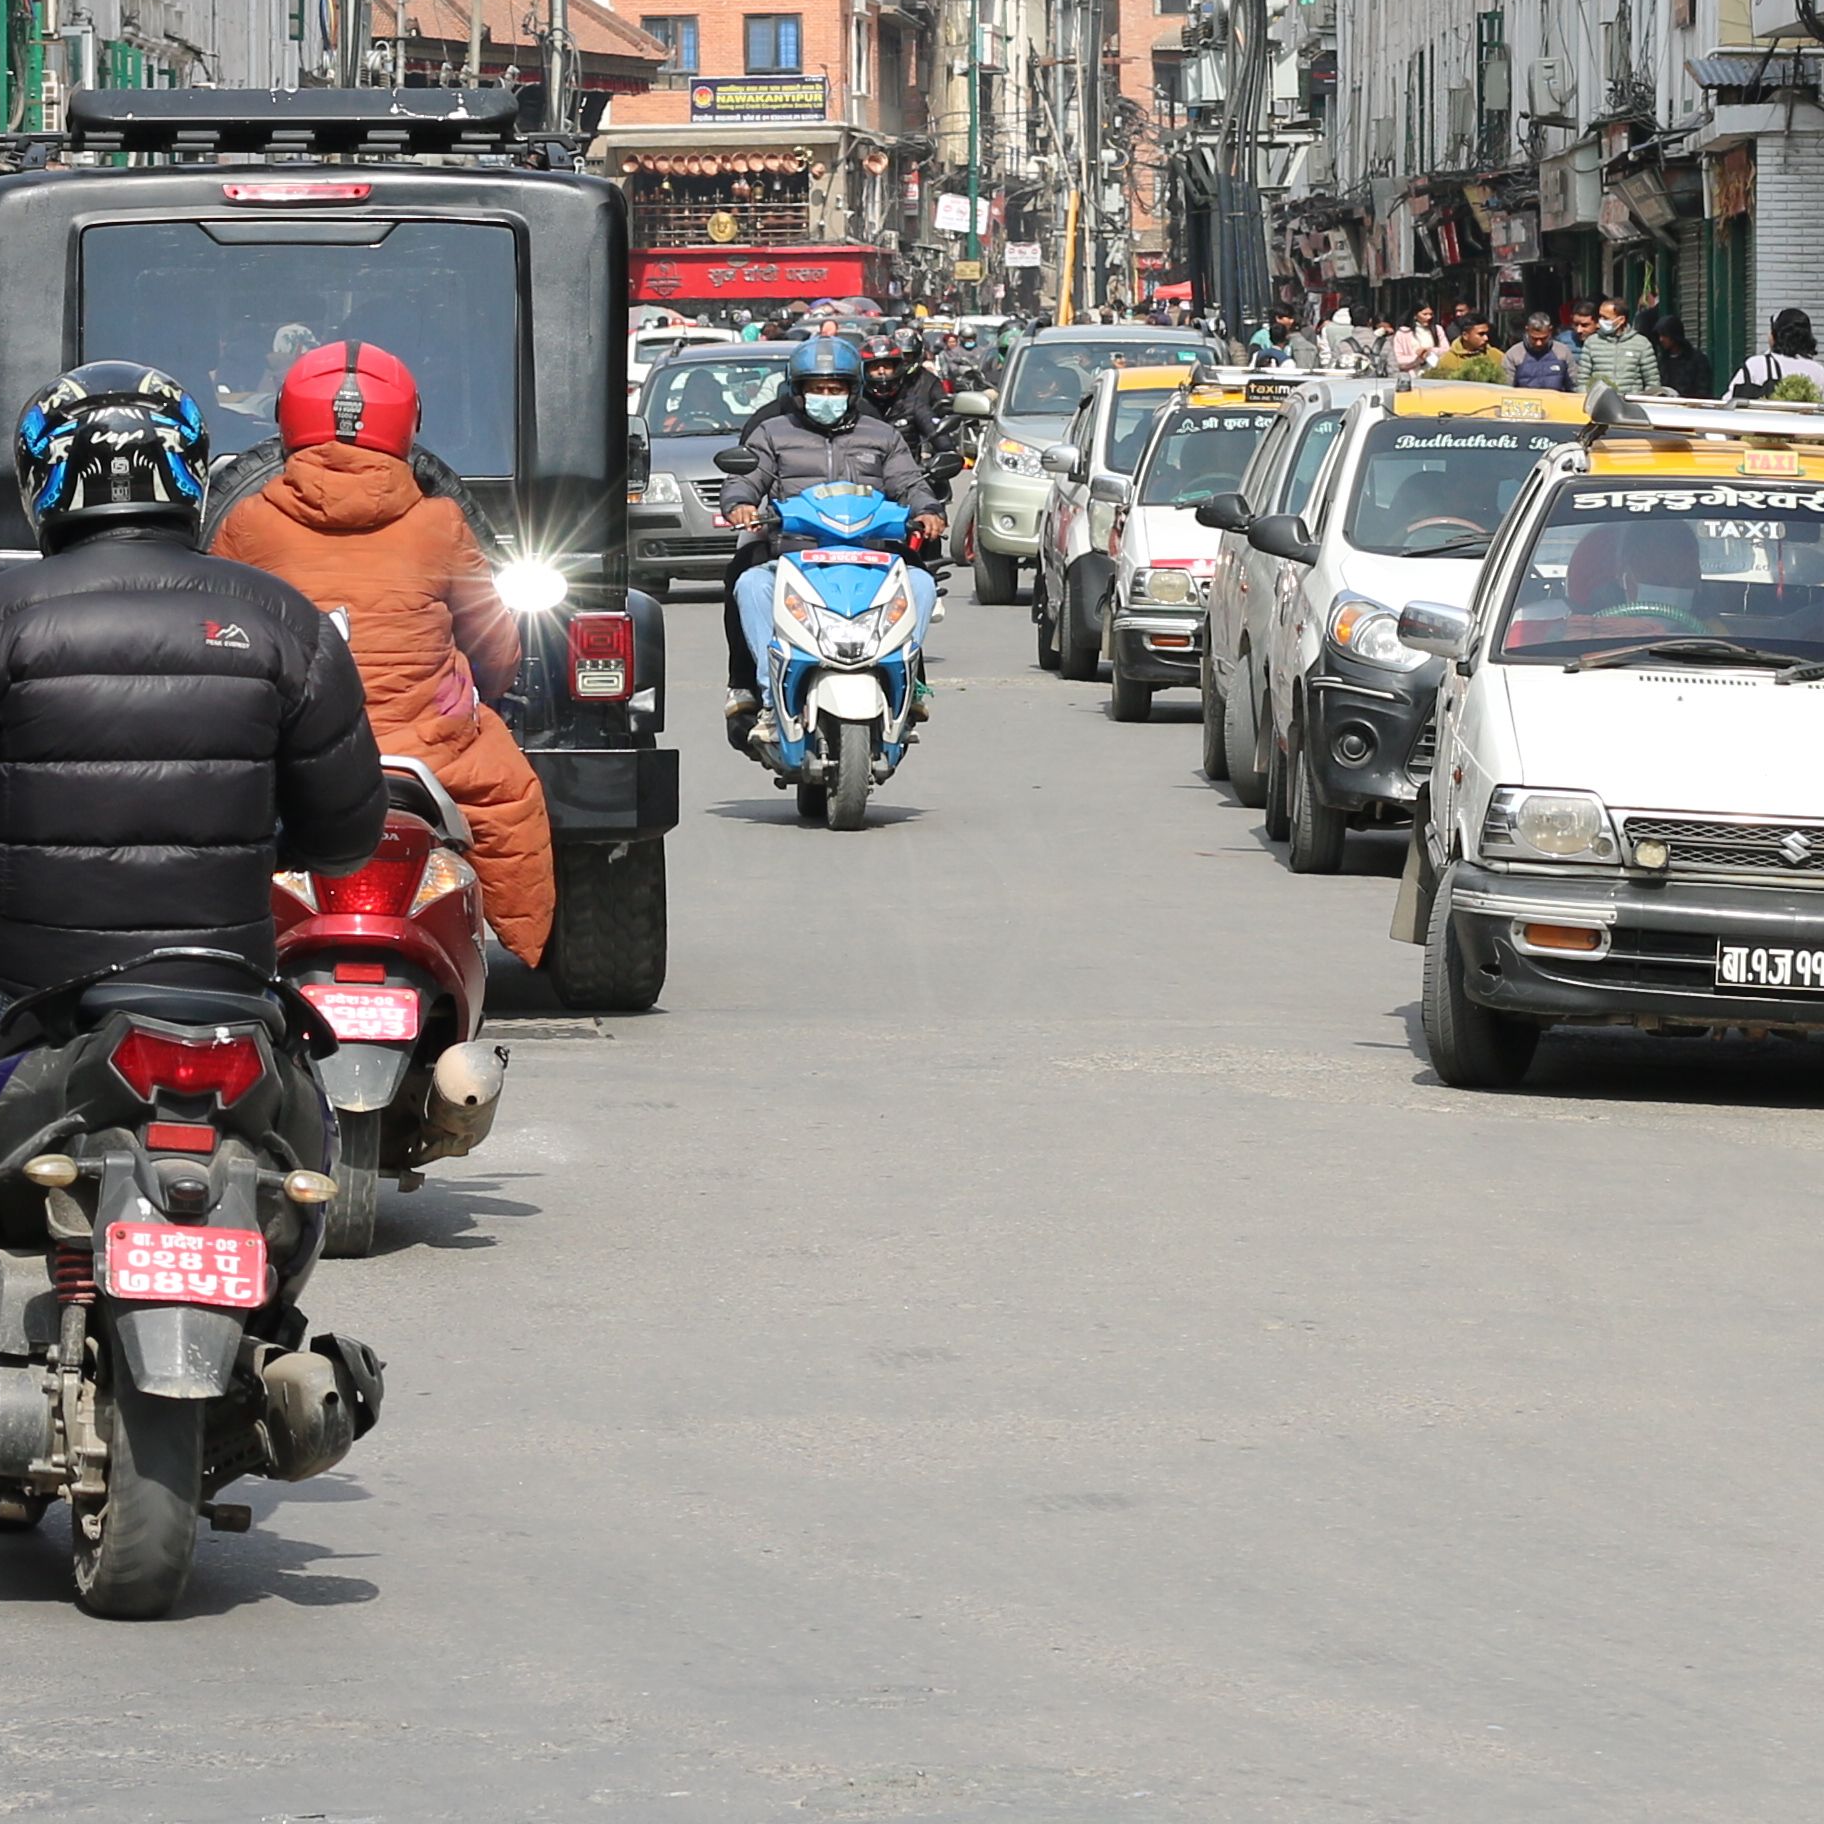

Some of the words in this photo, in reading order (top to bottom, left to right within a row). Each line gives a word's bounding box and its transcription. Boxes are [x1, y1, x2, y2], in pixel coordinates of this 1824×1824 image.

[716, 93, 823, 103] NAWAKANTIPUR
[1395, 432, 1518, 449] Budhathoki
[1746, 454, 1796, 472] TAXI
[127, 1249, 204, 1271] ०२४
[214, 1254, 241, 1275] प
